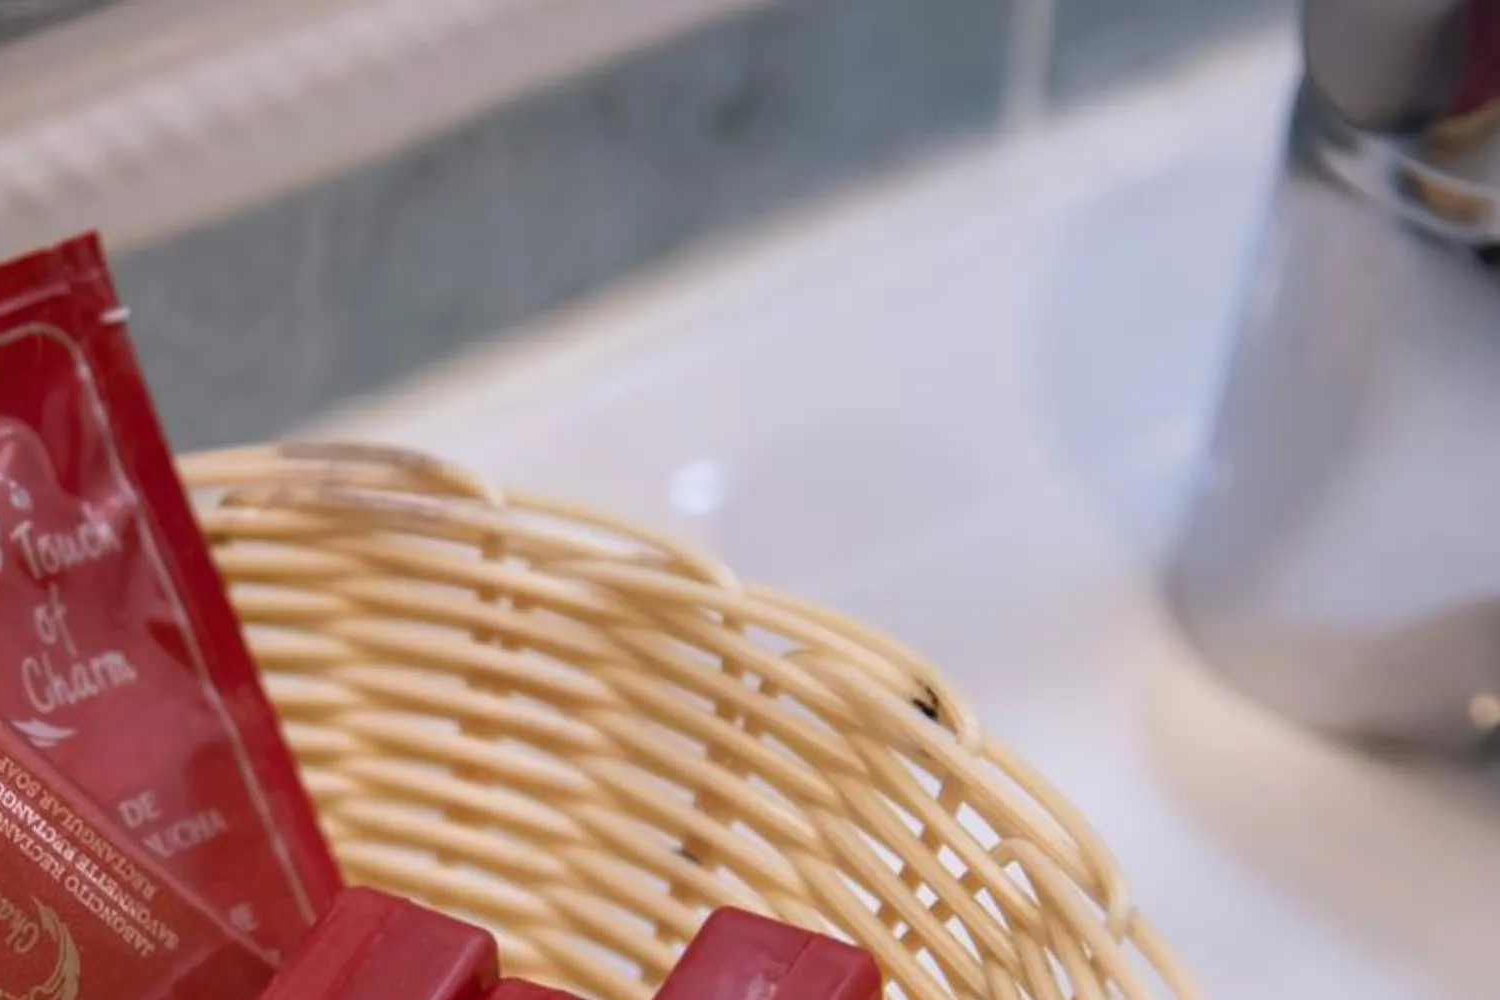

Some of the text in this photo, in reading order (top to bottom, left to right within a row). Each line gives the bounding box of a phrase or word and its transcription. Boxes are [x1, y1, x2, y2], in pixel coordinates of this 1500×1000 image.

[9, 500, 123, 579] Touch
[32, 582, 79, 658] of
[21, 651, 138, 714] Charm
[40, 789, 159, 901] RECTANGULAR
[117, 791, 162, 830] DE
[64, 876, 157, 958] JABONCITO
[74, 853, 180, 950] SAVONNETTE
